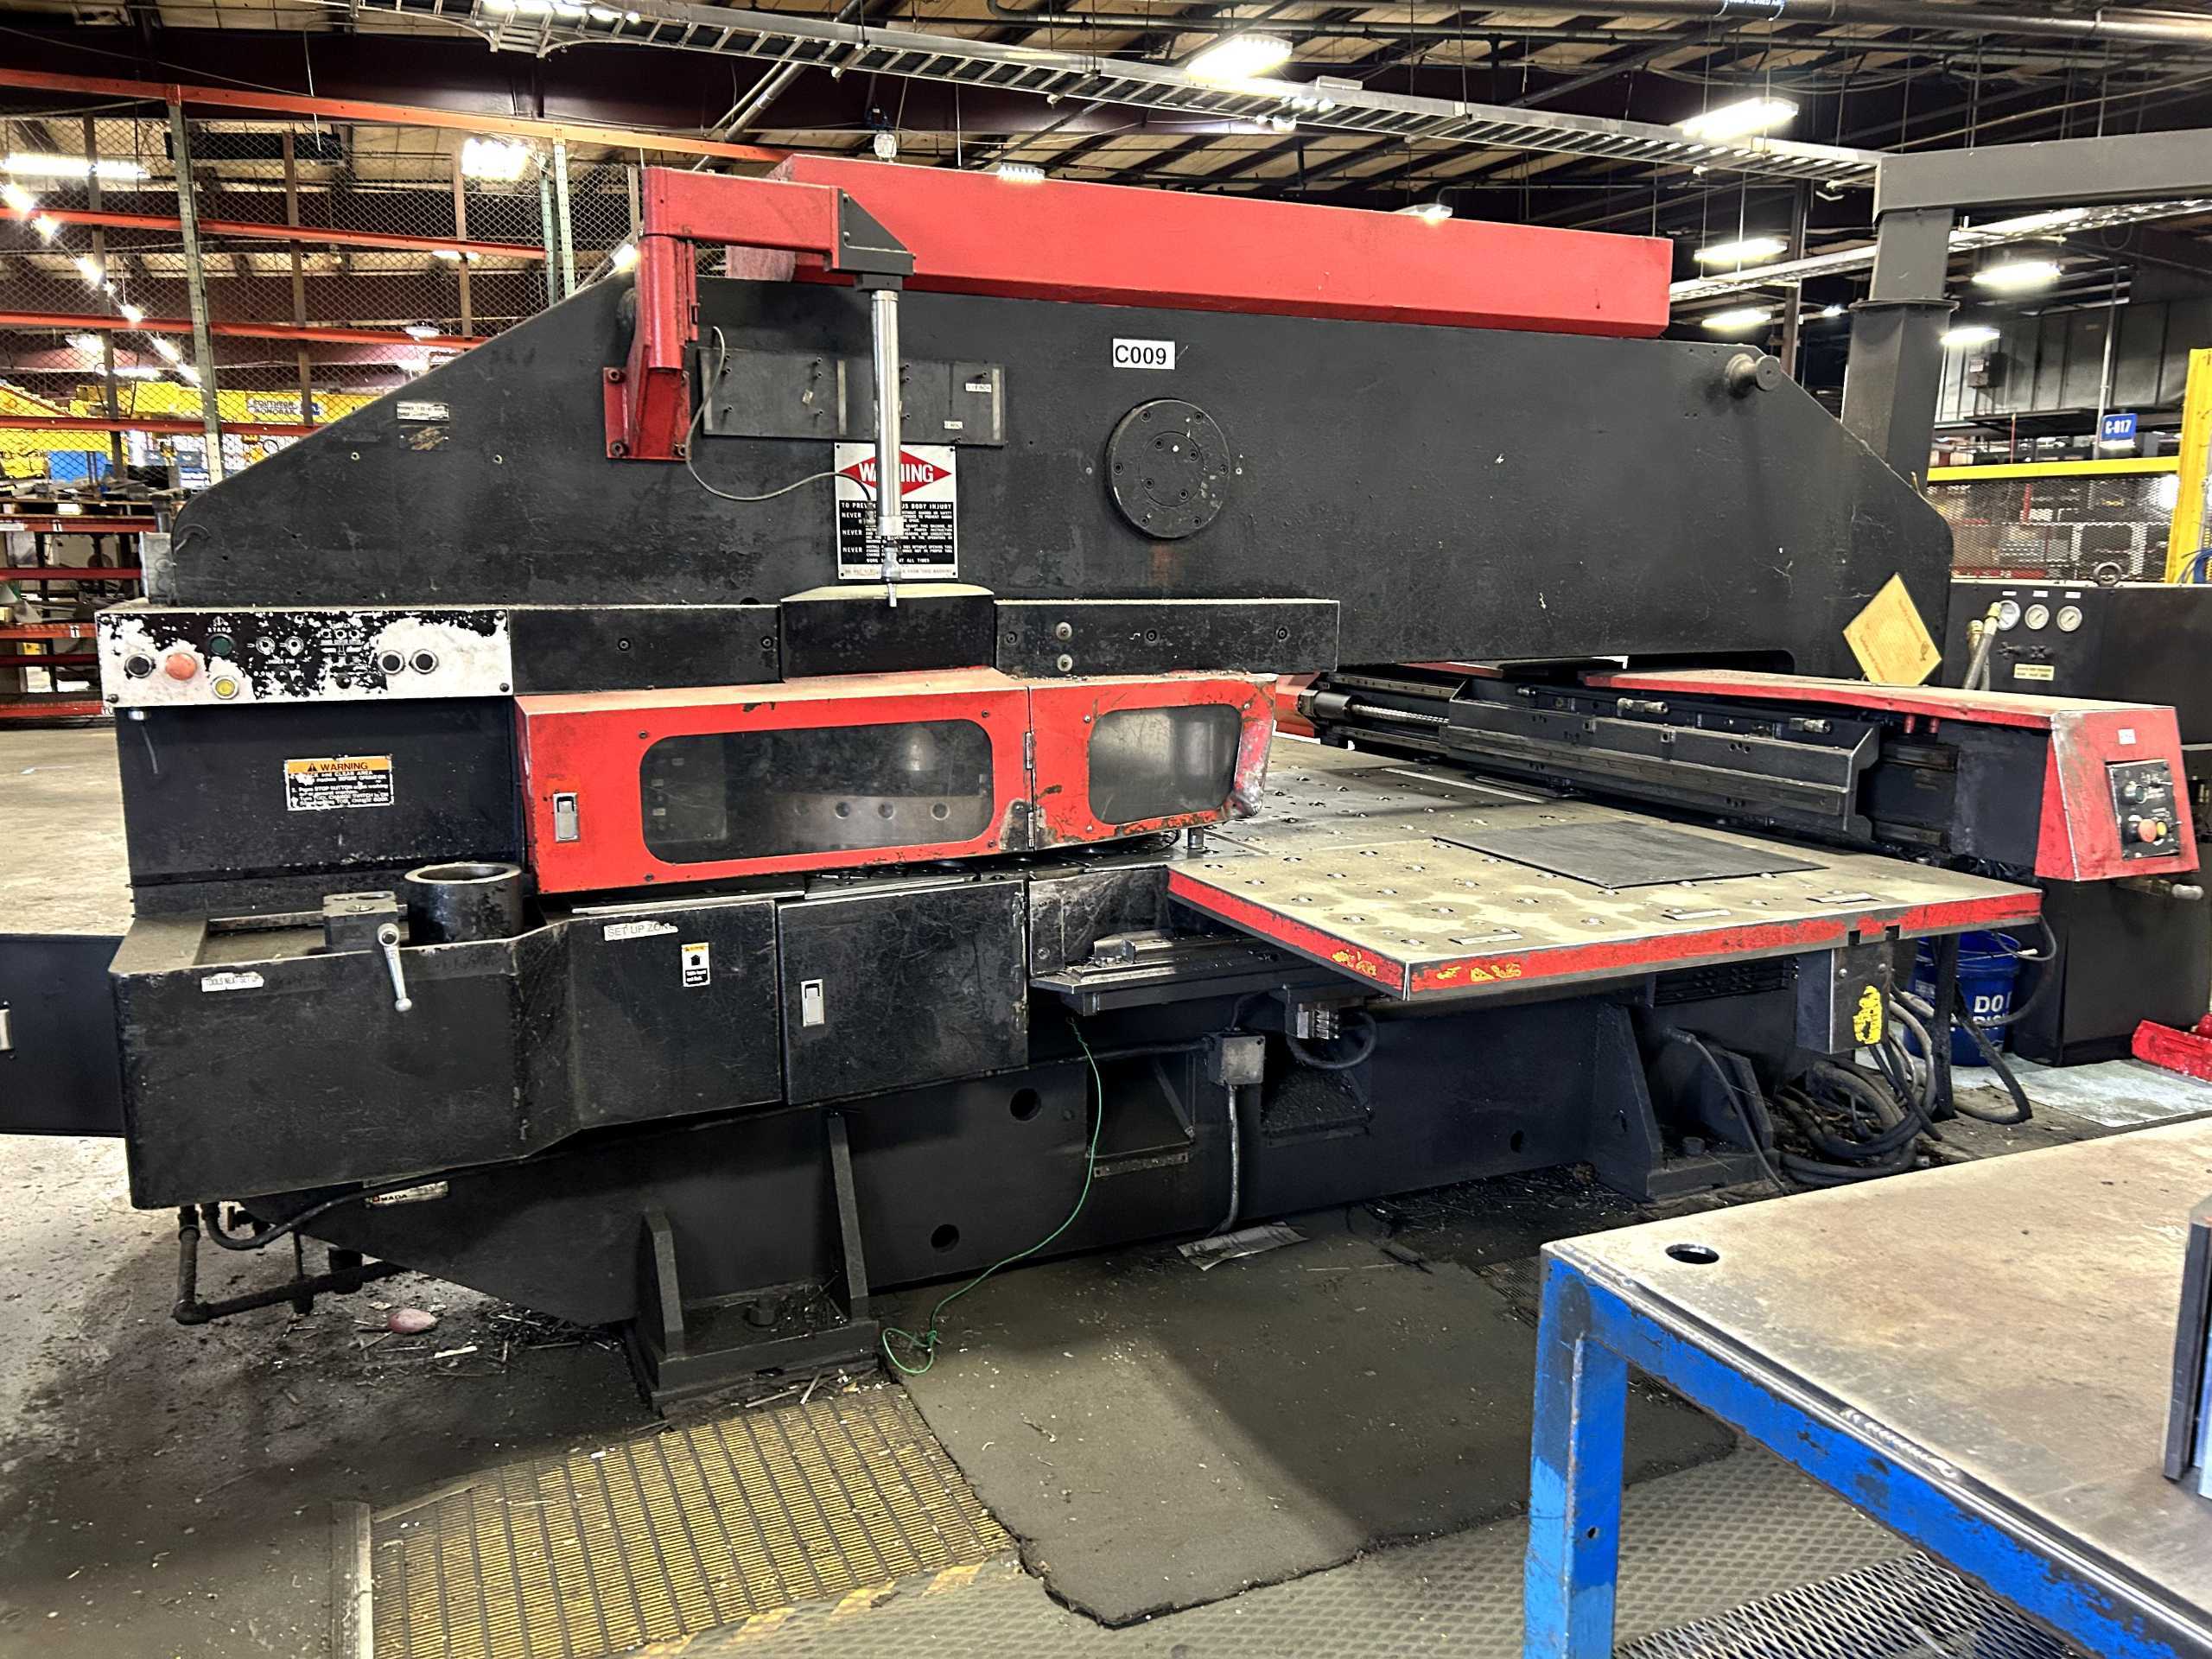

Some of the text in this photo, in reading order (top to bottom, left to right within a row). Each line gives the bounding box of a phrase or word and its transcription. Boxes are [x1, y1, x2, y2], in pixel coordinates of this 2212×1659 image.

[1115, 344, 1166, 365] C009
[2105, 419, 2132, 435] C-017
[321, 762, 368, 771] WARNING
[607, 925, 628, 938] SET
[630, 925, 645, 935] UP
